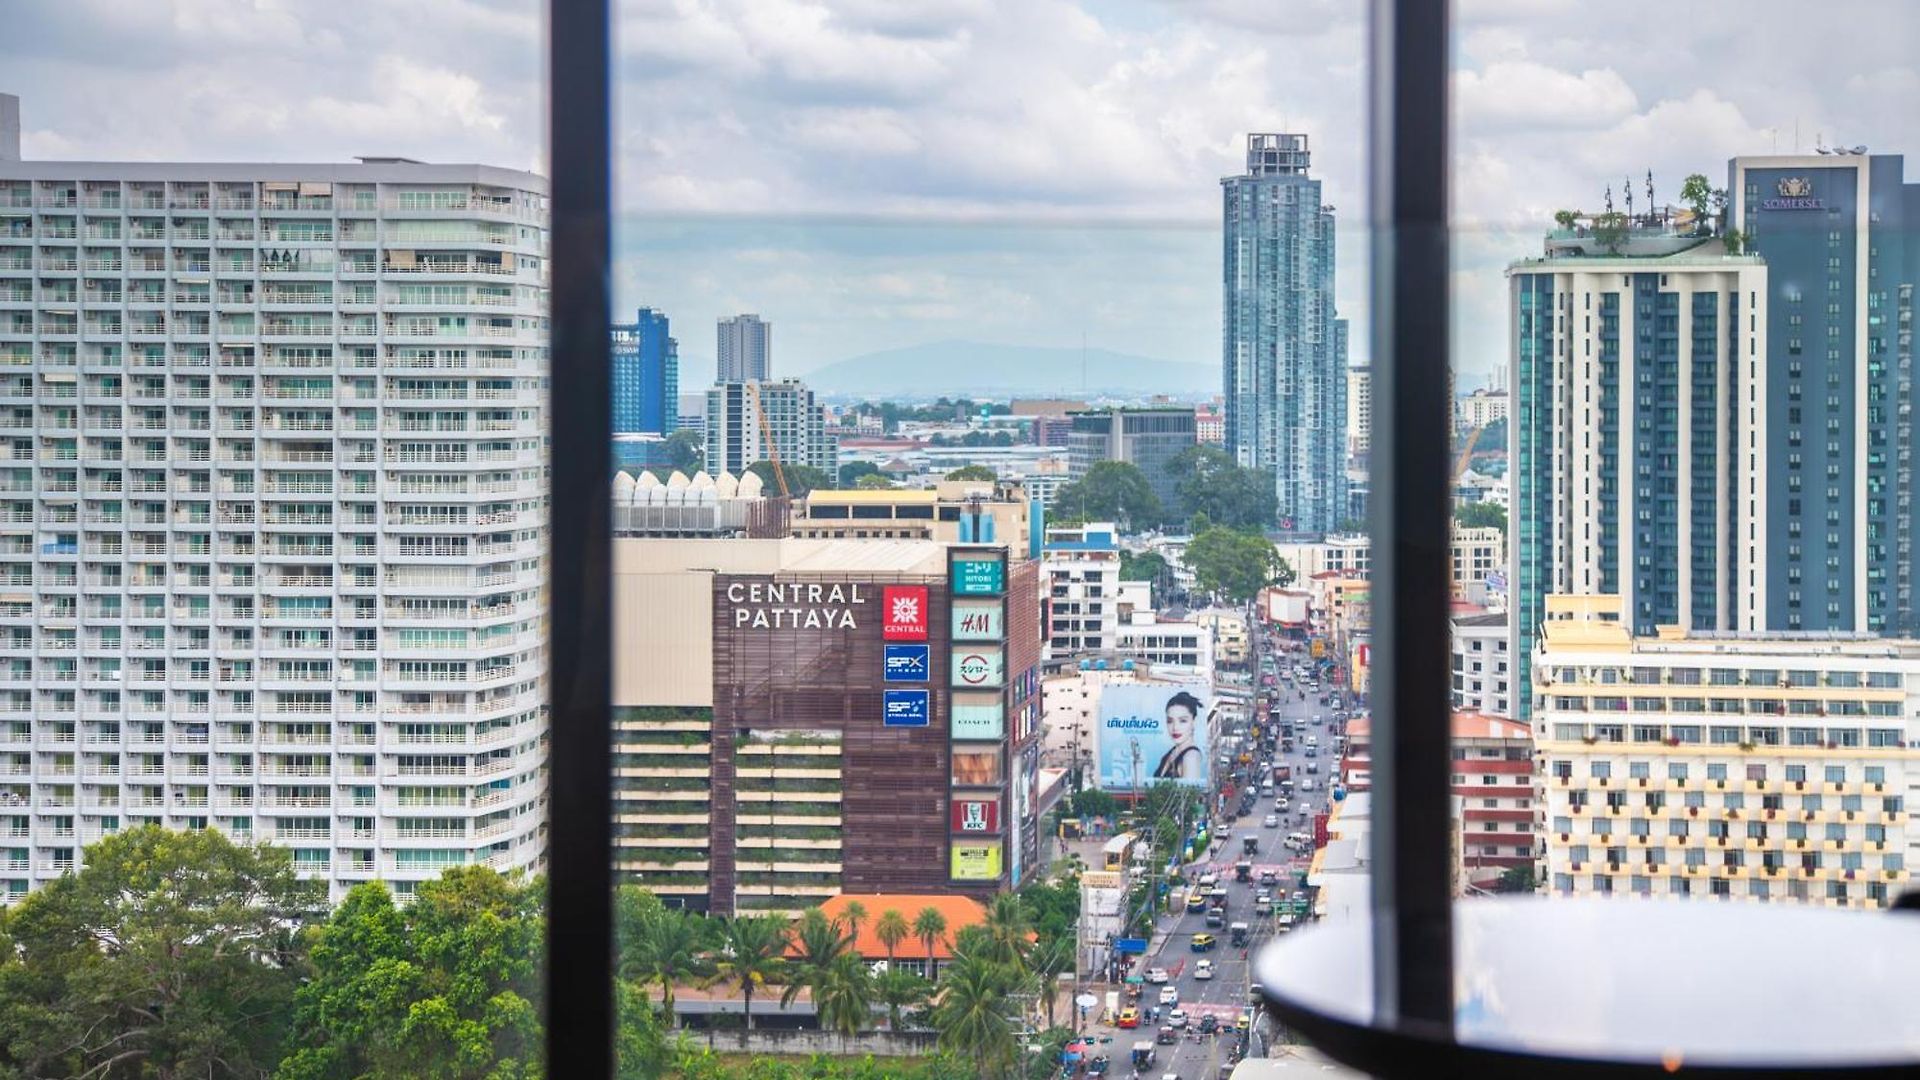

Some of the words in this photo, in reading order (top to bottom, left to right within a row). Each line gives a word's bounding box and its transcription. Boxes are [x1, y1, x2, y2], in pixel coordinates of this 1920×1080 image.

[1762, 199, 1824, 209] SOMERSET
[965, 562, 992, 573] ニトリ
[727, 583, 865, 604] CENTRAL
[735, 608, 857, 629] PATTAYA
[884, 625, 928, 633] CENTRAL
